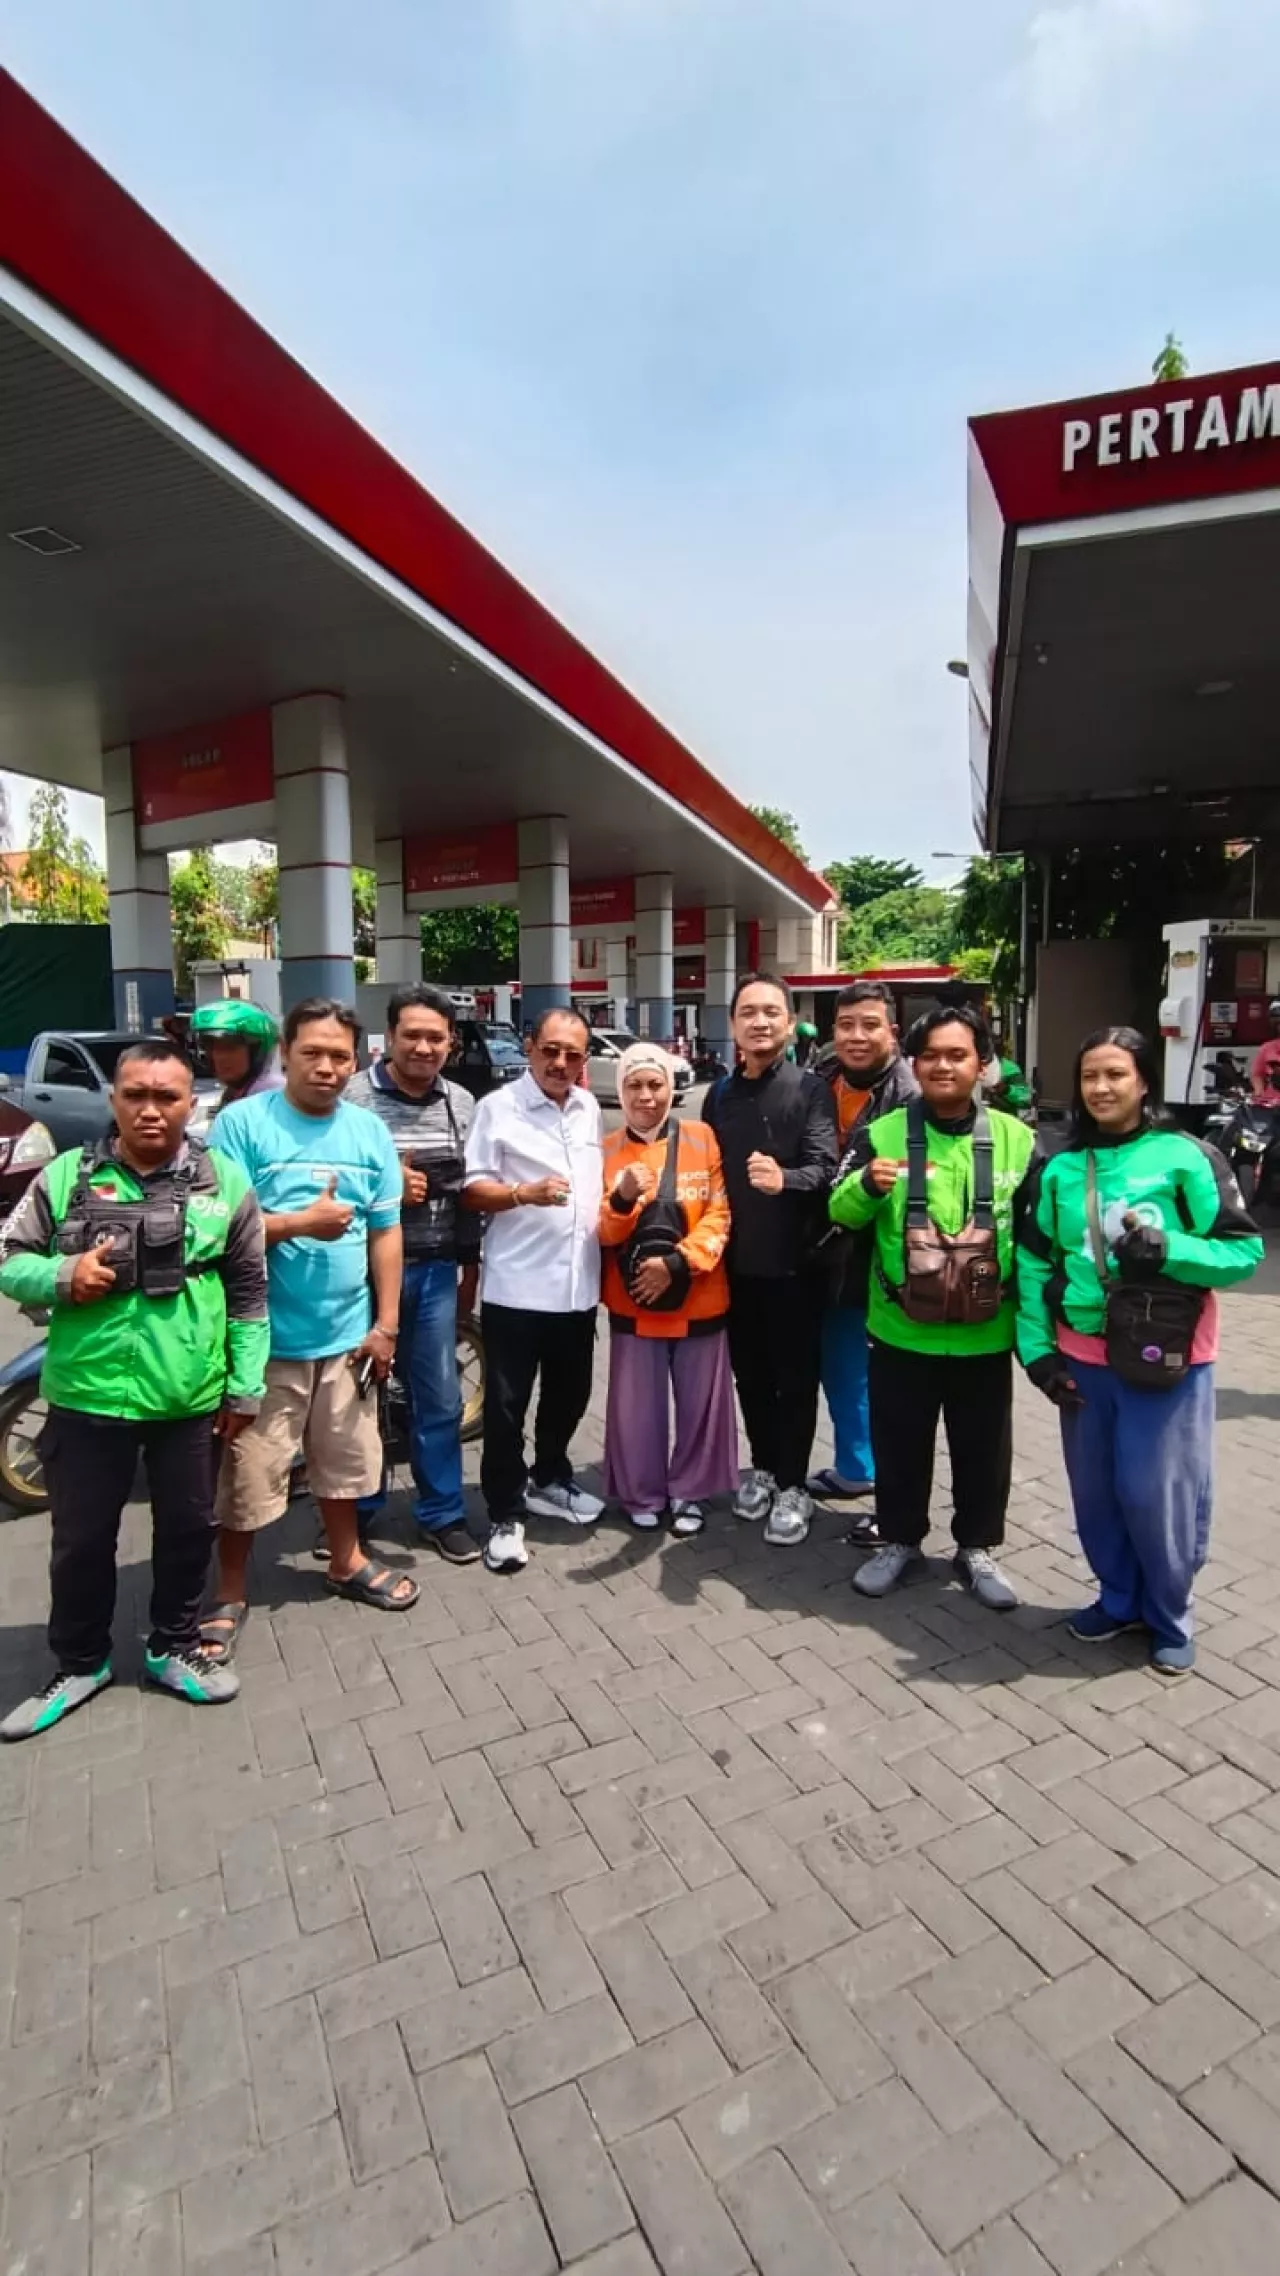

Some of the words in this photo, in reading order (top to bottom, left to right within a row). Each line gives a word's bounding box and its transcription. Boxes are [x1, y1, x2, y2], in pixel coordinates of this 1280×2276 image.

[1062, 383, 1280, 473] PERTAM
[676, 1185, 711, 1201] ood
[188, 1196, 229, 1218] oje
